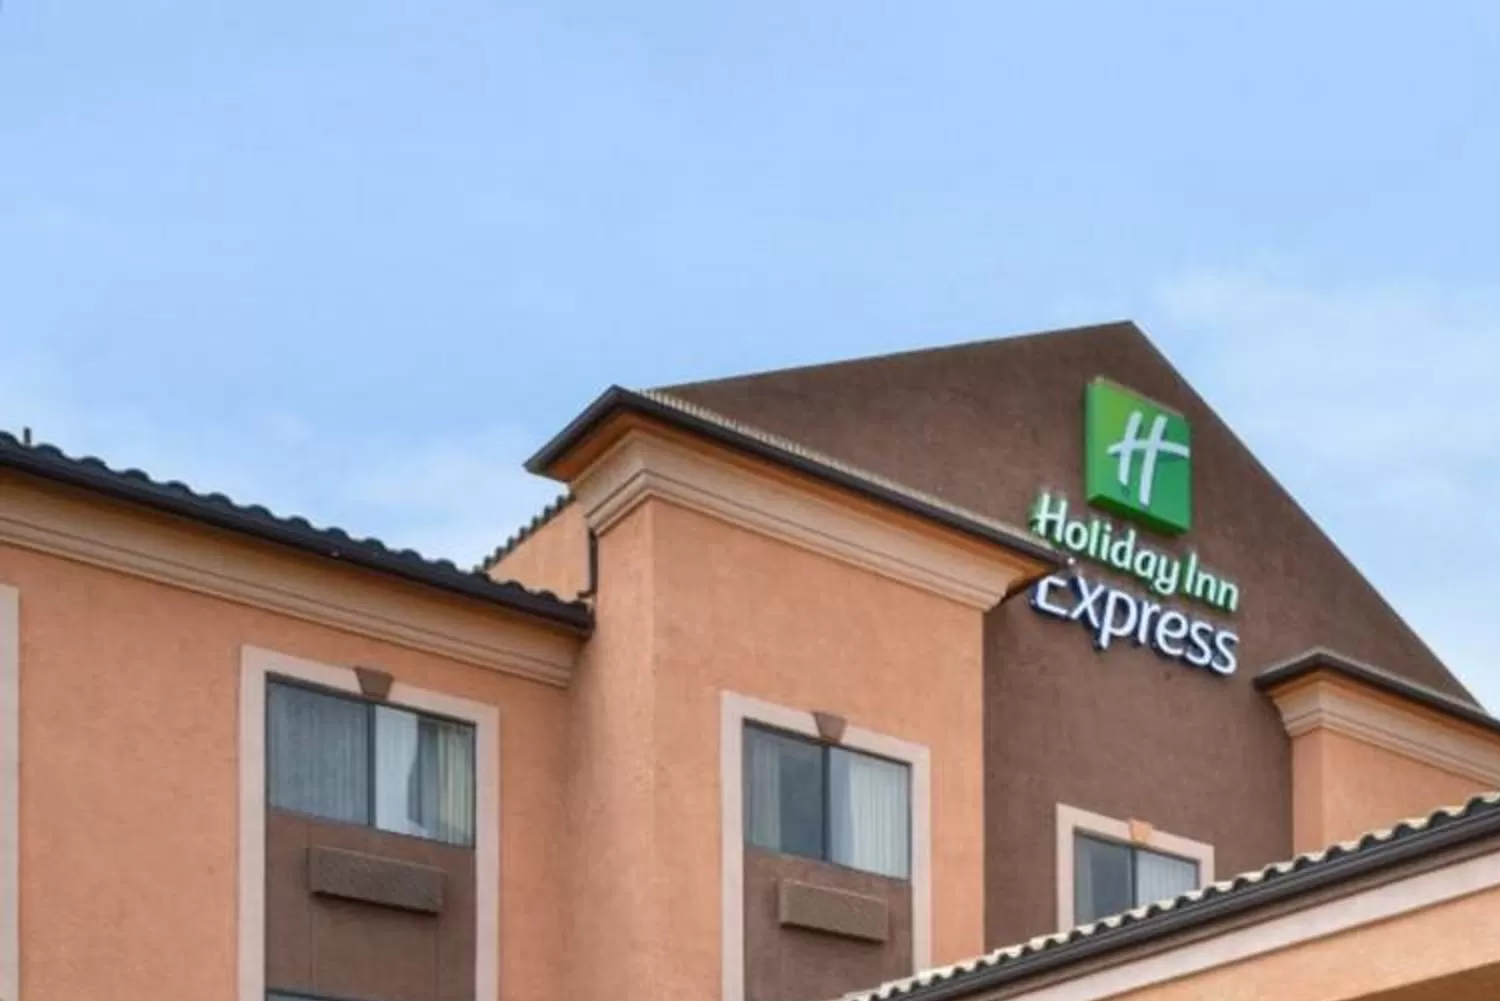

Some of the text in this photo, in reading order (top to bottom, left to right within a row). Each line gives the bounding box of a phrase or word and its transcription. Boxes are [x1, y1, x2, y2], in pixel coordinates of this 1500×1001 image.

[1106, 411, 1190, 505] H
[1034, 491, 1239, 612] Holiday Inn
